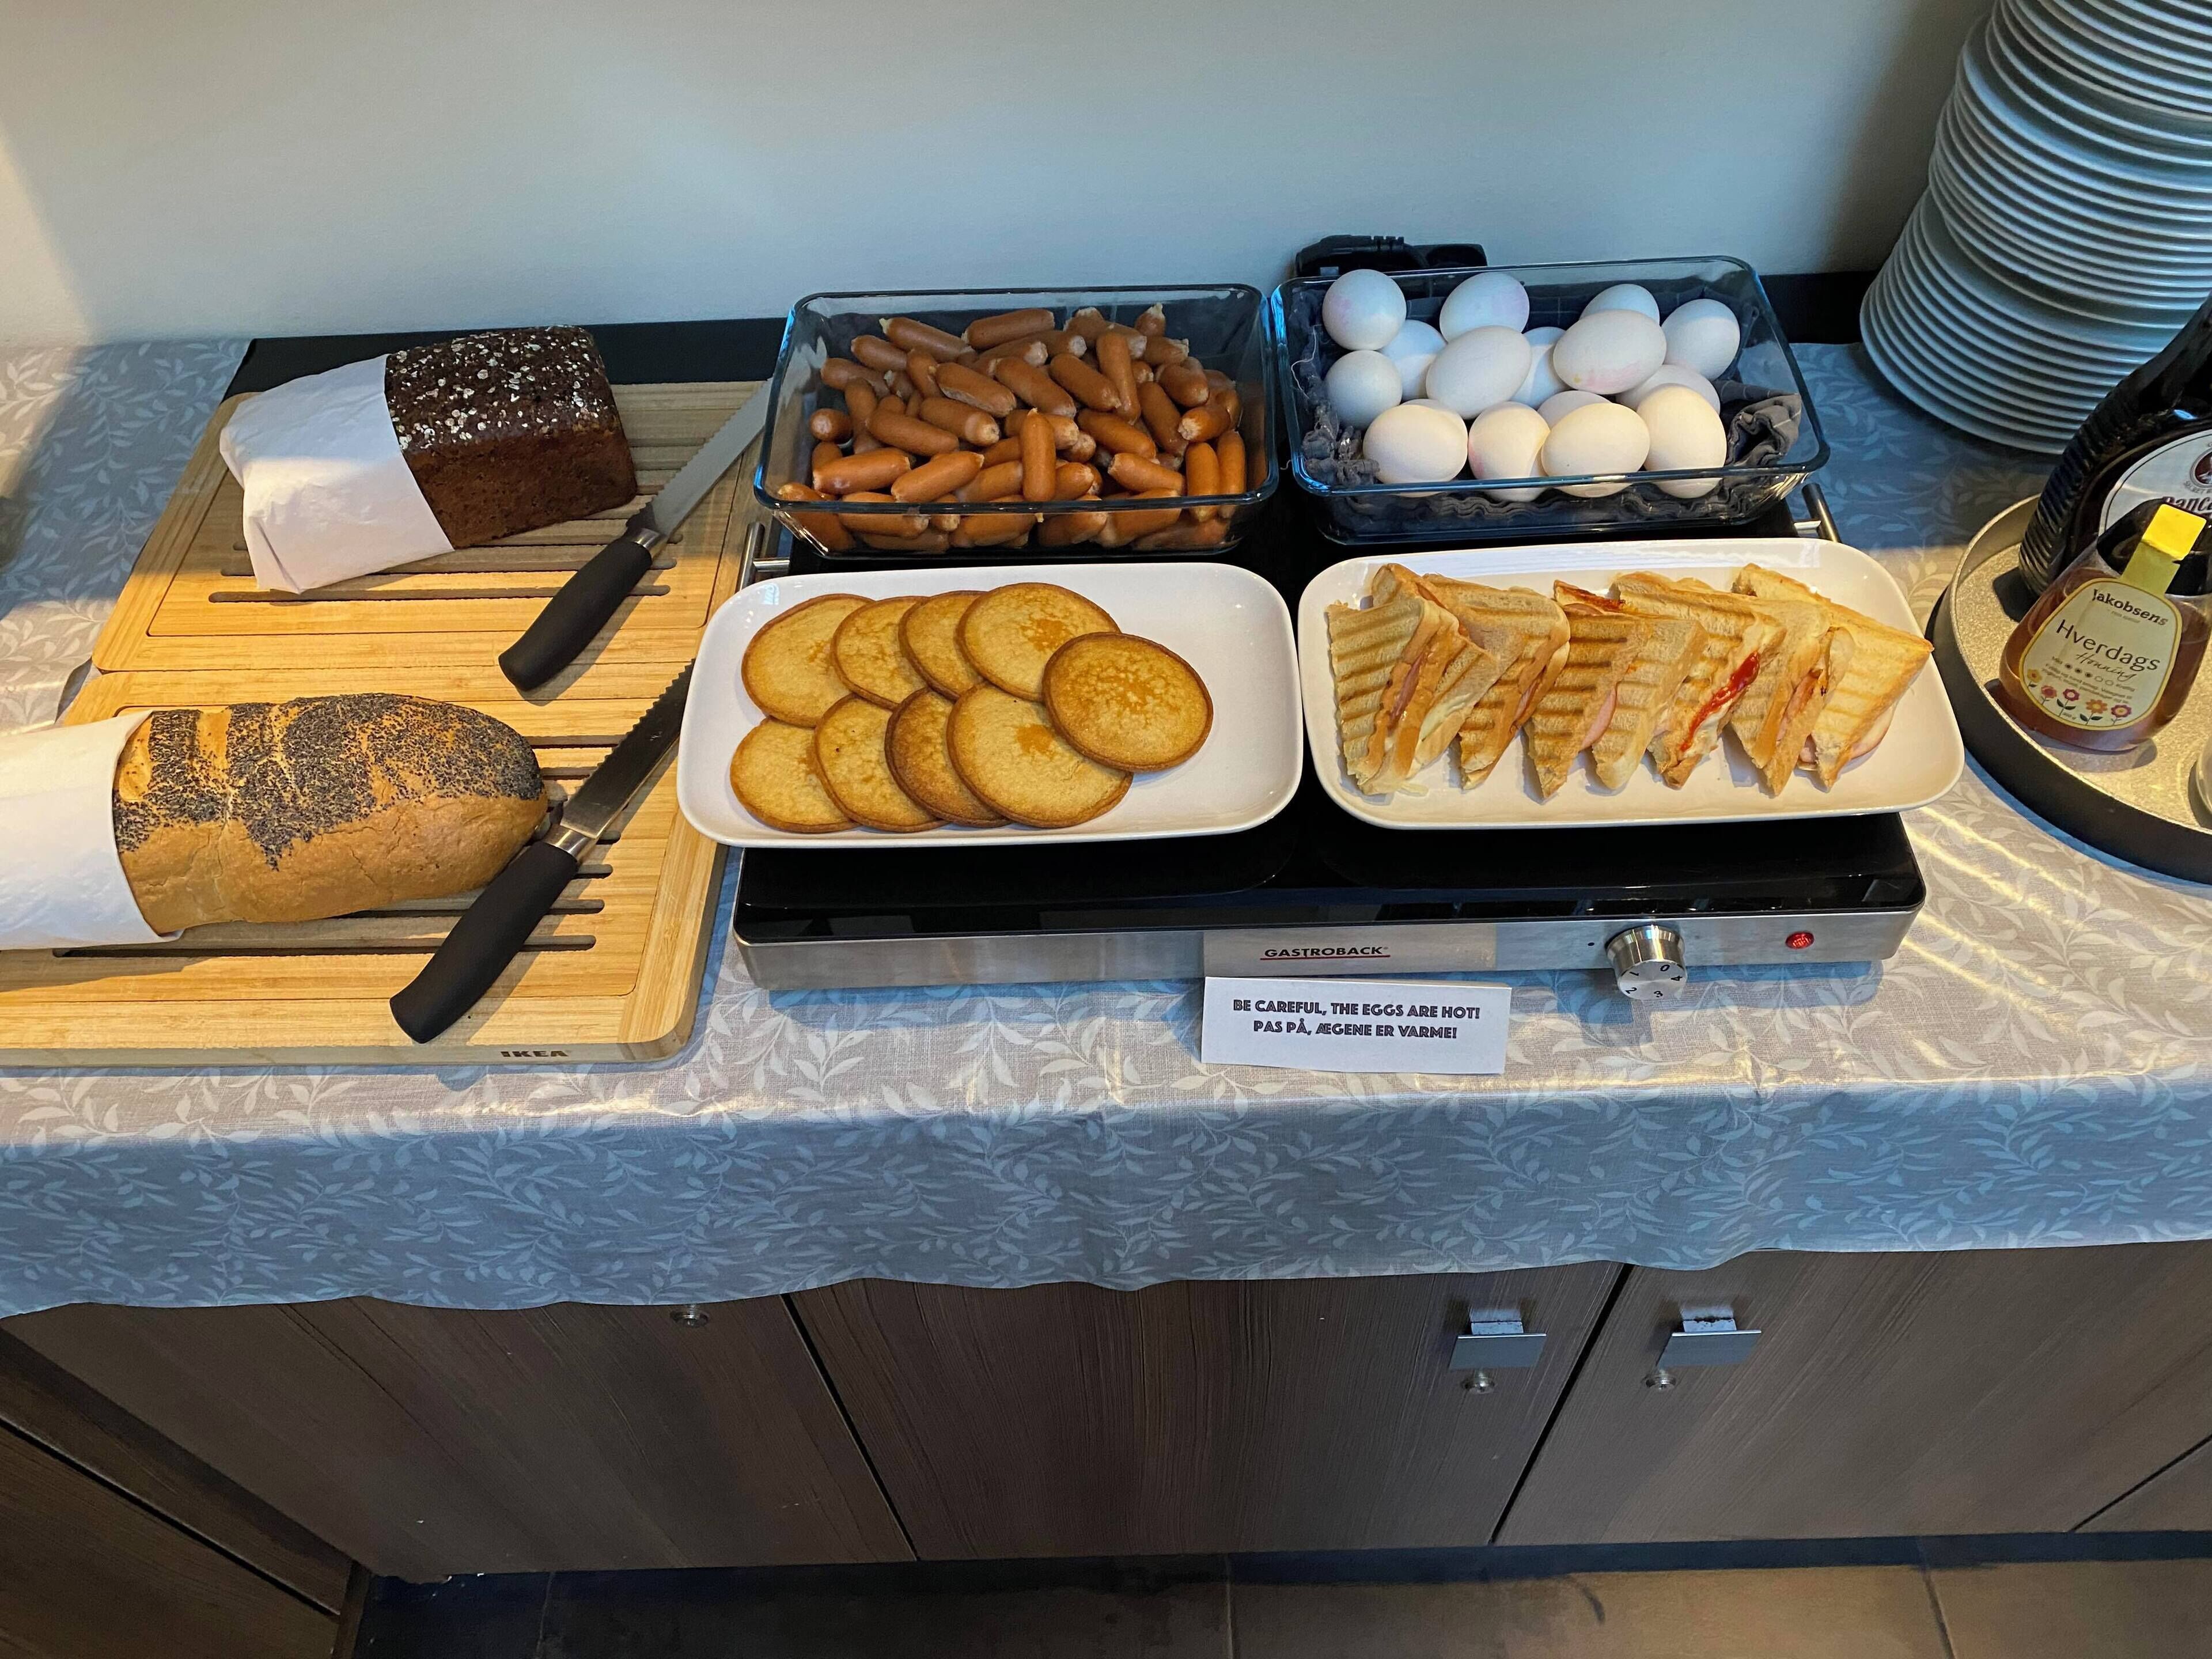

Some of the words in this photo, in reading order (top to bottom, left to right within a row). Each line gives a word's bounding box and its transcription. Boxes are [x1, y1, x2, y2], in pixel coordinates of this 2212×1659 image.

[2092, 589, 2168, 626] Jakobsens
[2056, 619, 2160, 672] Hverdags
[2075, 653, 2137, 681] Honning
[1264, 946, 1383, 958] GASTROBACK
[1233, 999, 1251, 1012] BE
[1255, 1000, 1327, 1016] CAREFUL,
[1331, 1002, 1359, 1015] THE
[1362, 1003, 1404, 1016] EGGS
[1407, 1005, 1438, 1018] ARE
[1442, 1006, 1480, 1019] HOT!
[1253, 1020, 1283, 1033] PAS
[1286, 1018, 1312, 1035] PÅ,
[1315, 1022, 1372, 1036] ÆGENE
[1376, 1025, 1395, 1036] ER
[1398, 1025, 1457, 1039] VARME!
